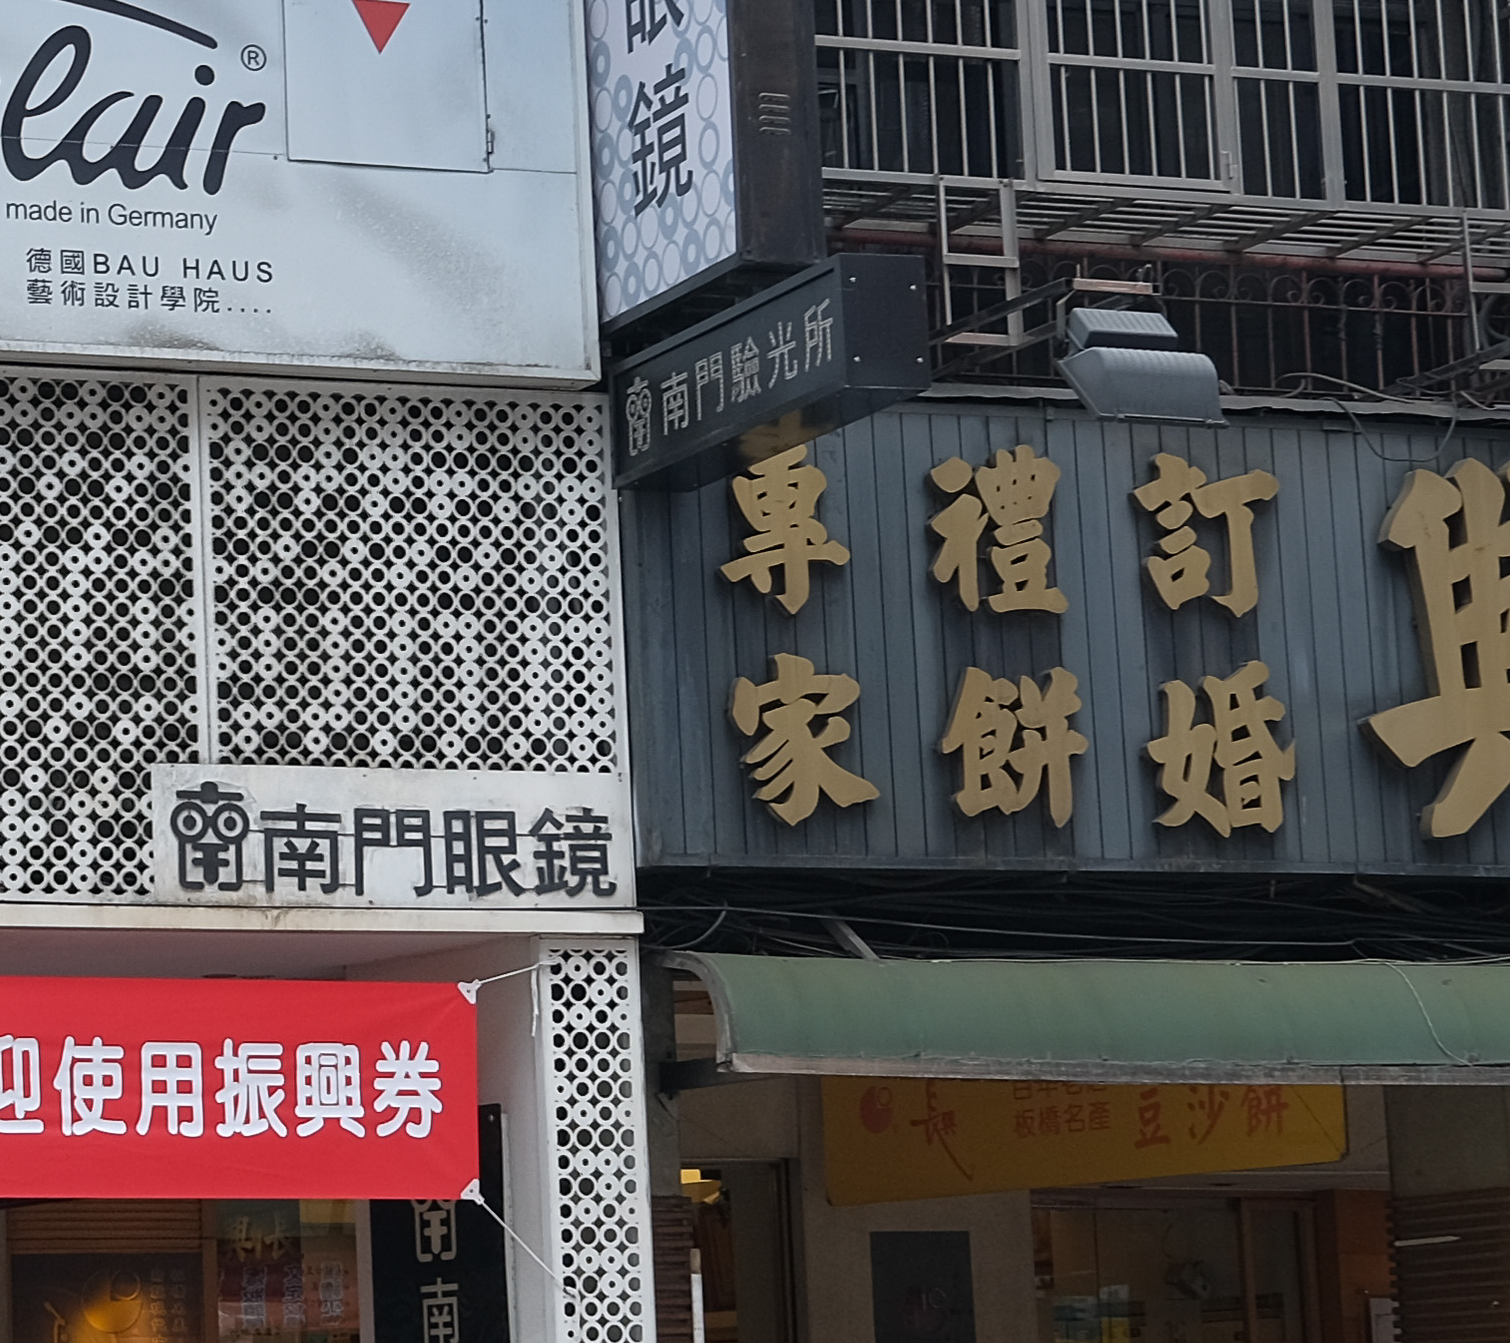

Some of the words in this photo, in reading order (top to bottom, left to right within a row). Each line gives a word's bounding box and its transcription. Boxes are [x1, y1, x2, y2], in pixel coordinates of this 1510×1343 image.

[5, 198, 72, 224] made
[79, 201, 100, 225] in
[107, 202, 217, 237] Germany
[181, 257, 276, 285] HAUS
[661, 298, 836, 437] 南門驗光所
[719, 444, 881, 827] 專家
[928, 444, 1089, 827] 禮餅
[1131, 452, 1296, 837] 訂婚
[260, 800, 618, 900] 南門眼鏡
[1013, 1103, 1111, 1138] 板橋名產
[1134, 1085, 1289, 1150] 豆沙餅
